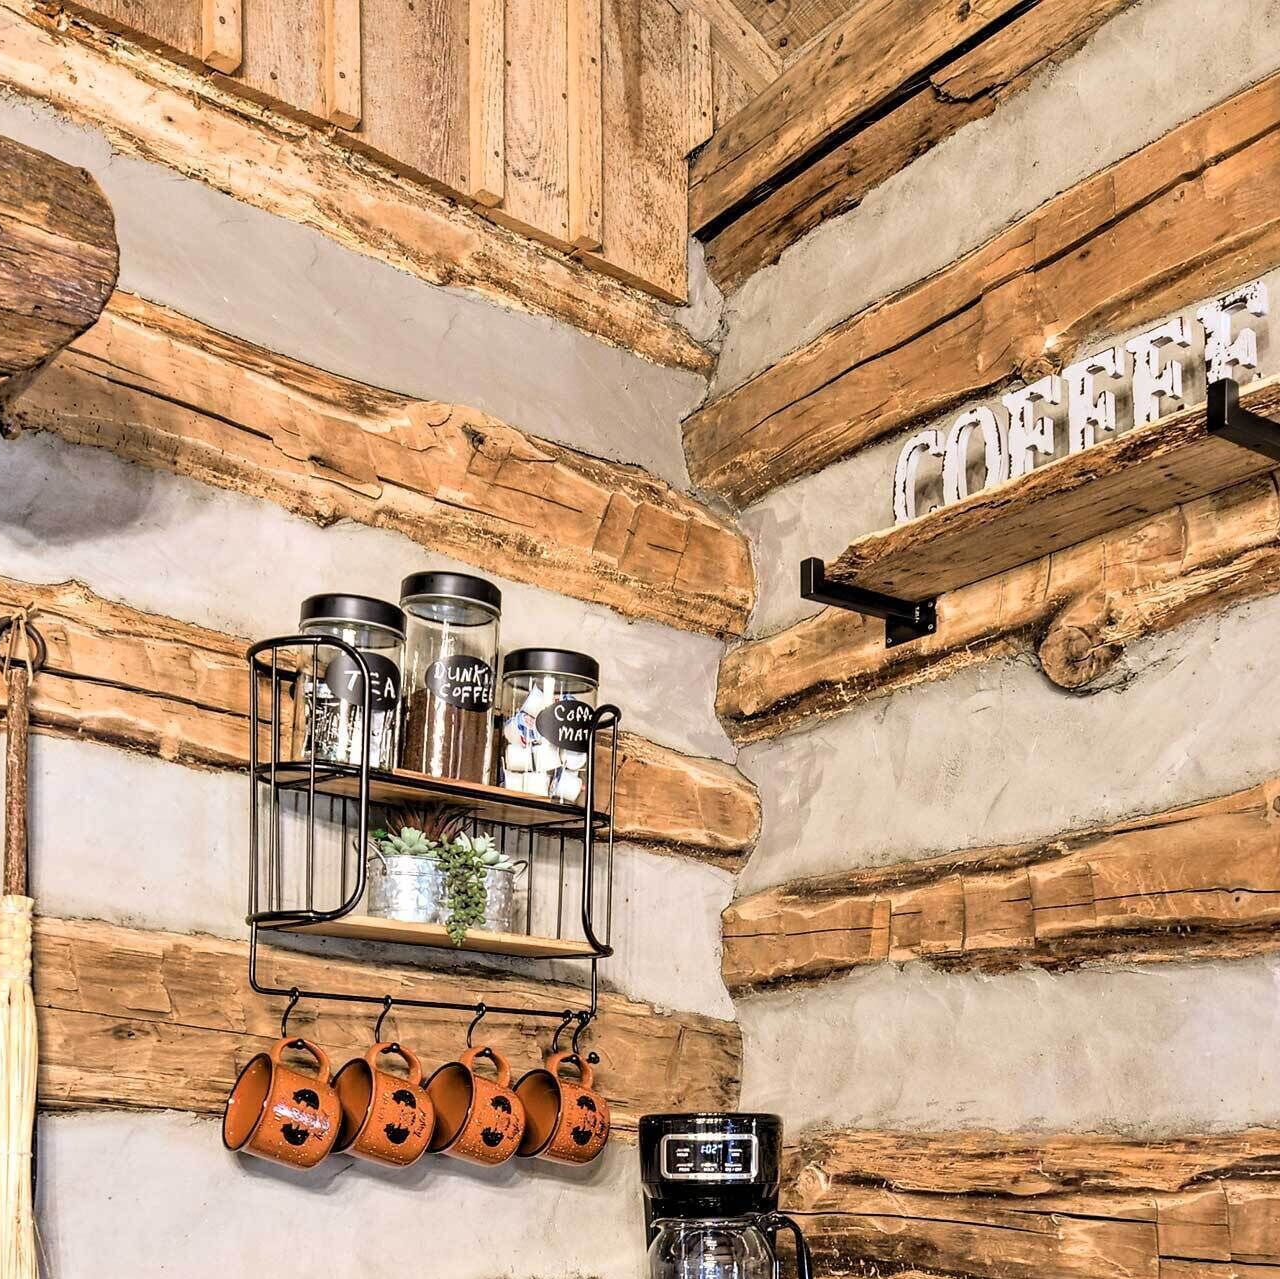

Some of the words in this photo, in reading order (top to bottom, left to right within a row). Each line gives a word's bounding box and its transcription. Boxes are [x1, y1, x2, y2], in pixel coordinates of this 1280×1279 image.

[893, 280, 1269, 525] COFFEE
[343, 669, 396, 701] TEA
[440, 683, 494, 704] COFFEE
[558, 726, 589, 741] MAT
